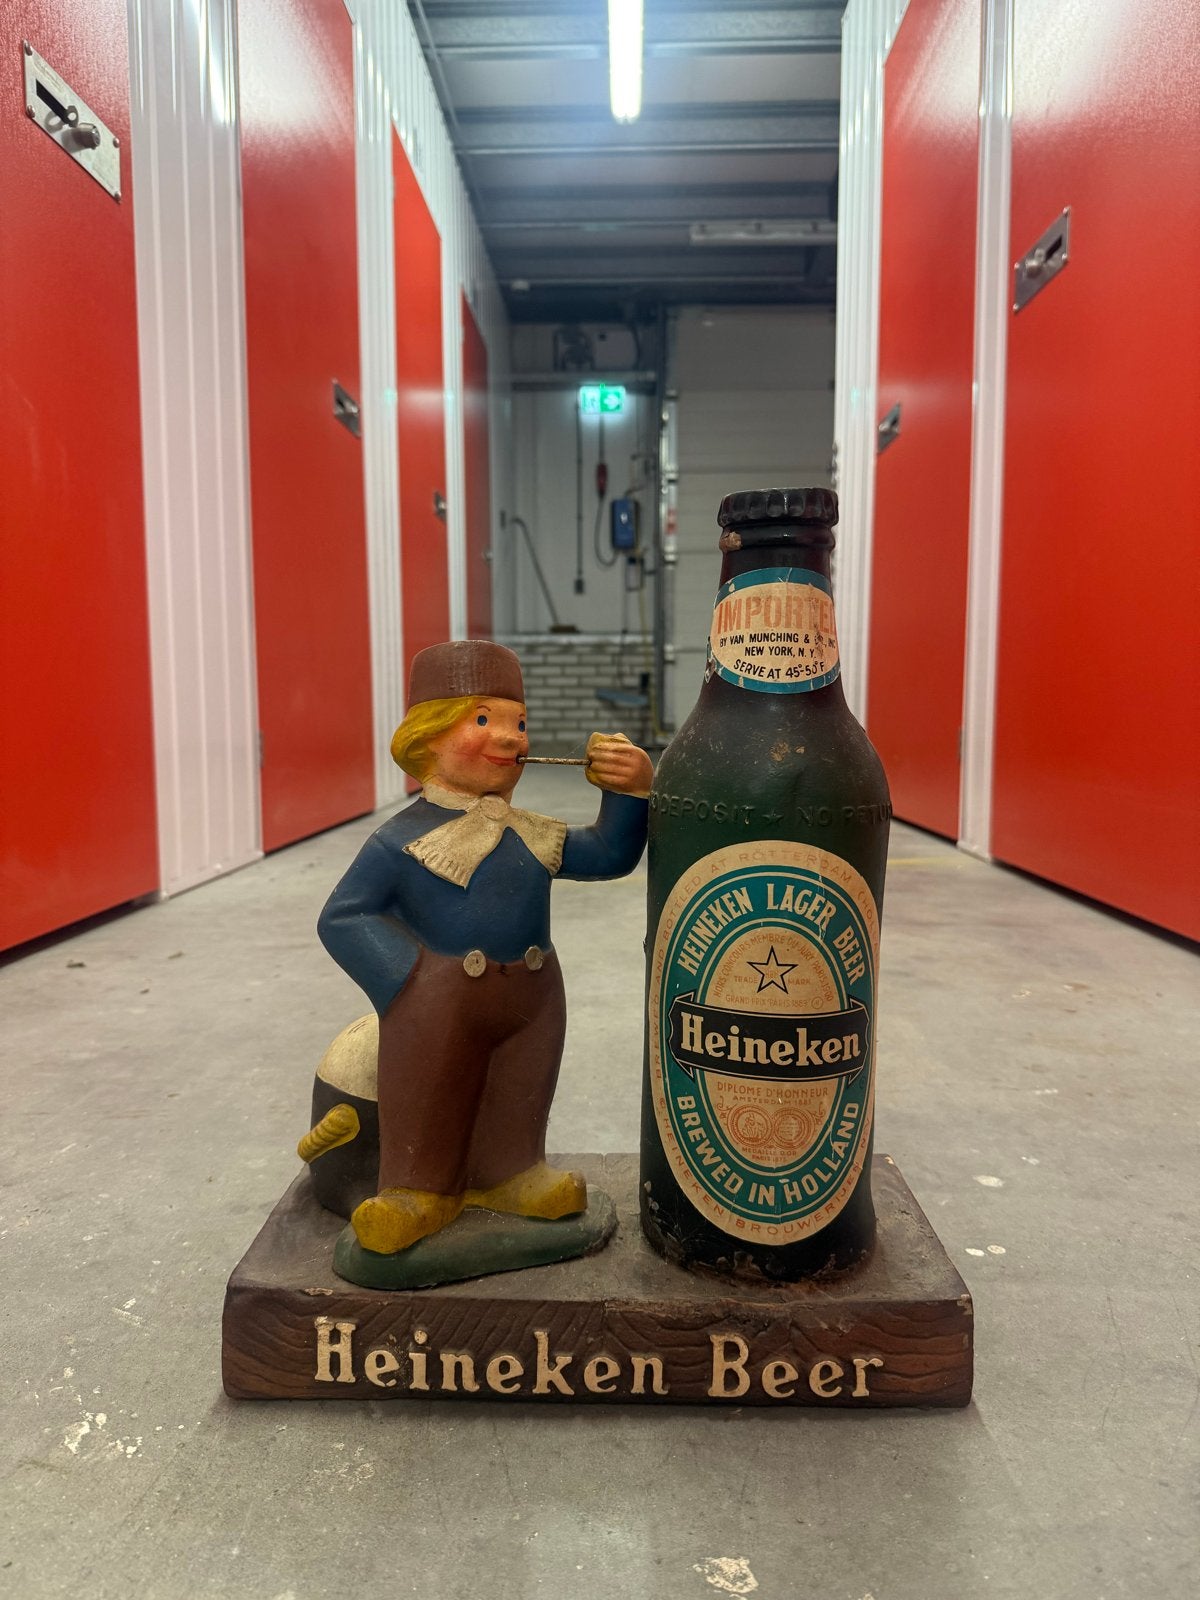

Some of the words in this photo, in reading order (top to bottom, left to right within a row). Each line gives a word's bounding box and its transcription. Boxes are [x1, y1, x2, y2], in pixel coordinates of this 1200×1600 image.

[719, 636, 727, 648] BY
[730, 635, 744, 645] VAN
[749, 632, 799, 643] MUNCHING
[803, 633, 810, 644] &
[744, 646, 764, 657] NEW
[768, 646, 796, 659] YORK,
[733, 659, 765, 678] SERVE
[767, 668, 781, 679] AT
[711, 858, 727, 874] AT
[738, 849, 853, 884] ROTTERDAM
[662, 876, 702, 941] BOTTLED
[677, 886, 754, 977] HEINEKEN
[766, 882, 838, 931] LAGER
[832, 925, 866, 987] BEER
[656, 949, 665, 984] AND
[653, 994, 662, 1079] BREWED
[680, 1011, 861, 1067] Heineken
[717, 1081, 762, 1097] DIPLOME
[663, 1118, 725, 1217] HEINEKEN
[676, 1095, 744, 1195] BREWED
[748, 1182, 775, 1207] IN
[783, 1102, 859, 1205] HOLLAND
[314, 1315, 671, 1396] Heineken
[707, 1332, 884, 1398] Beer
